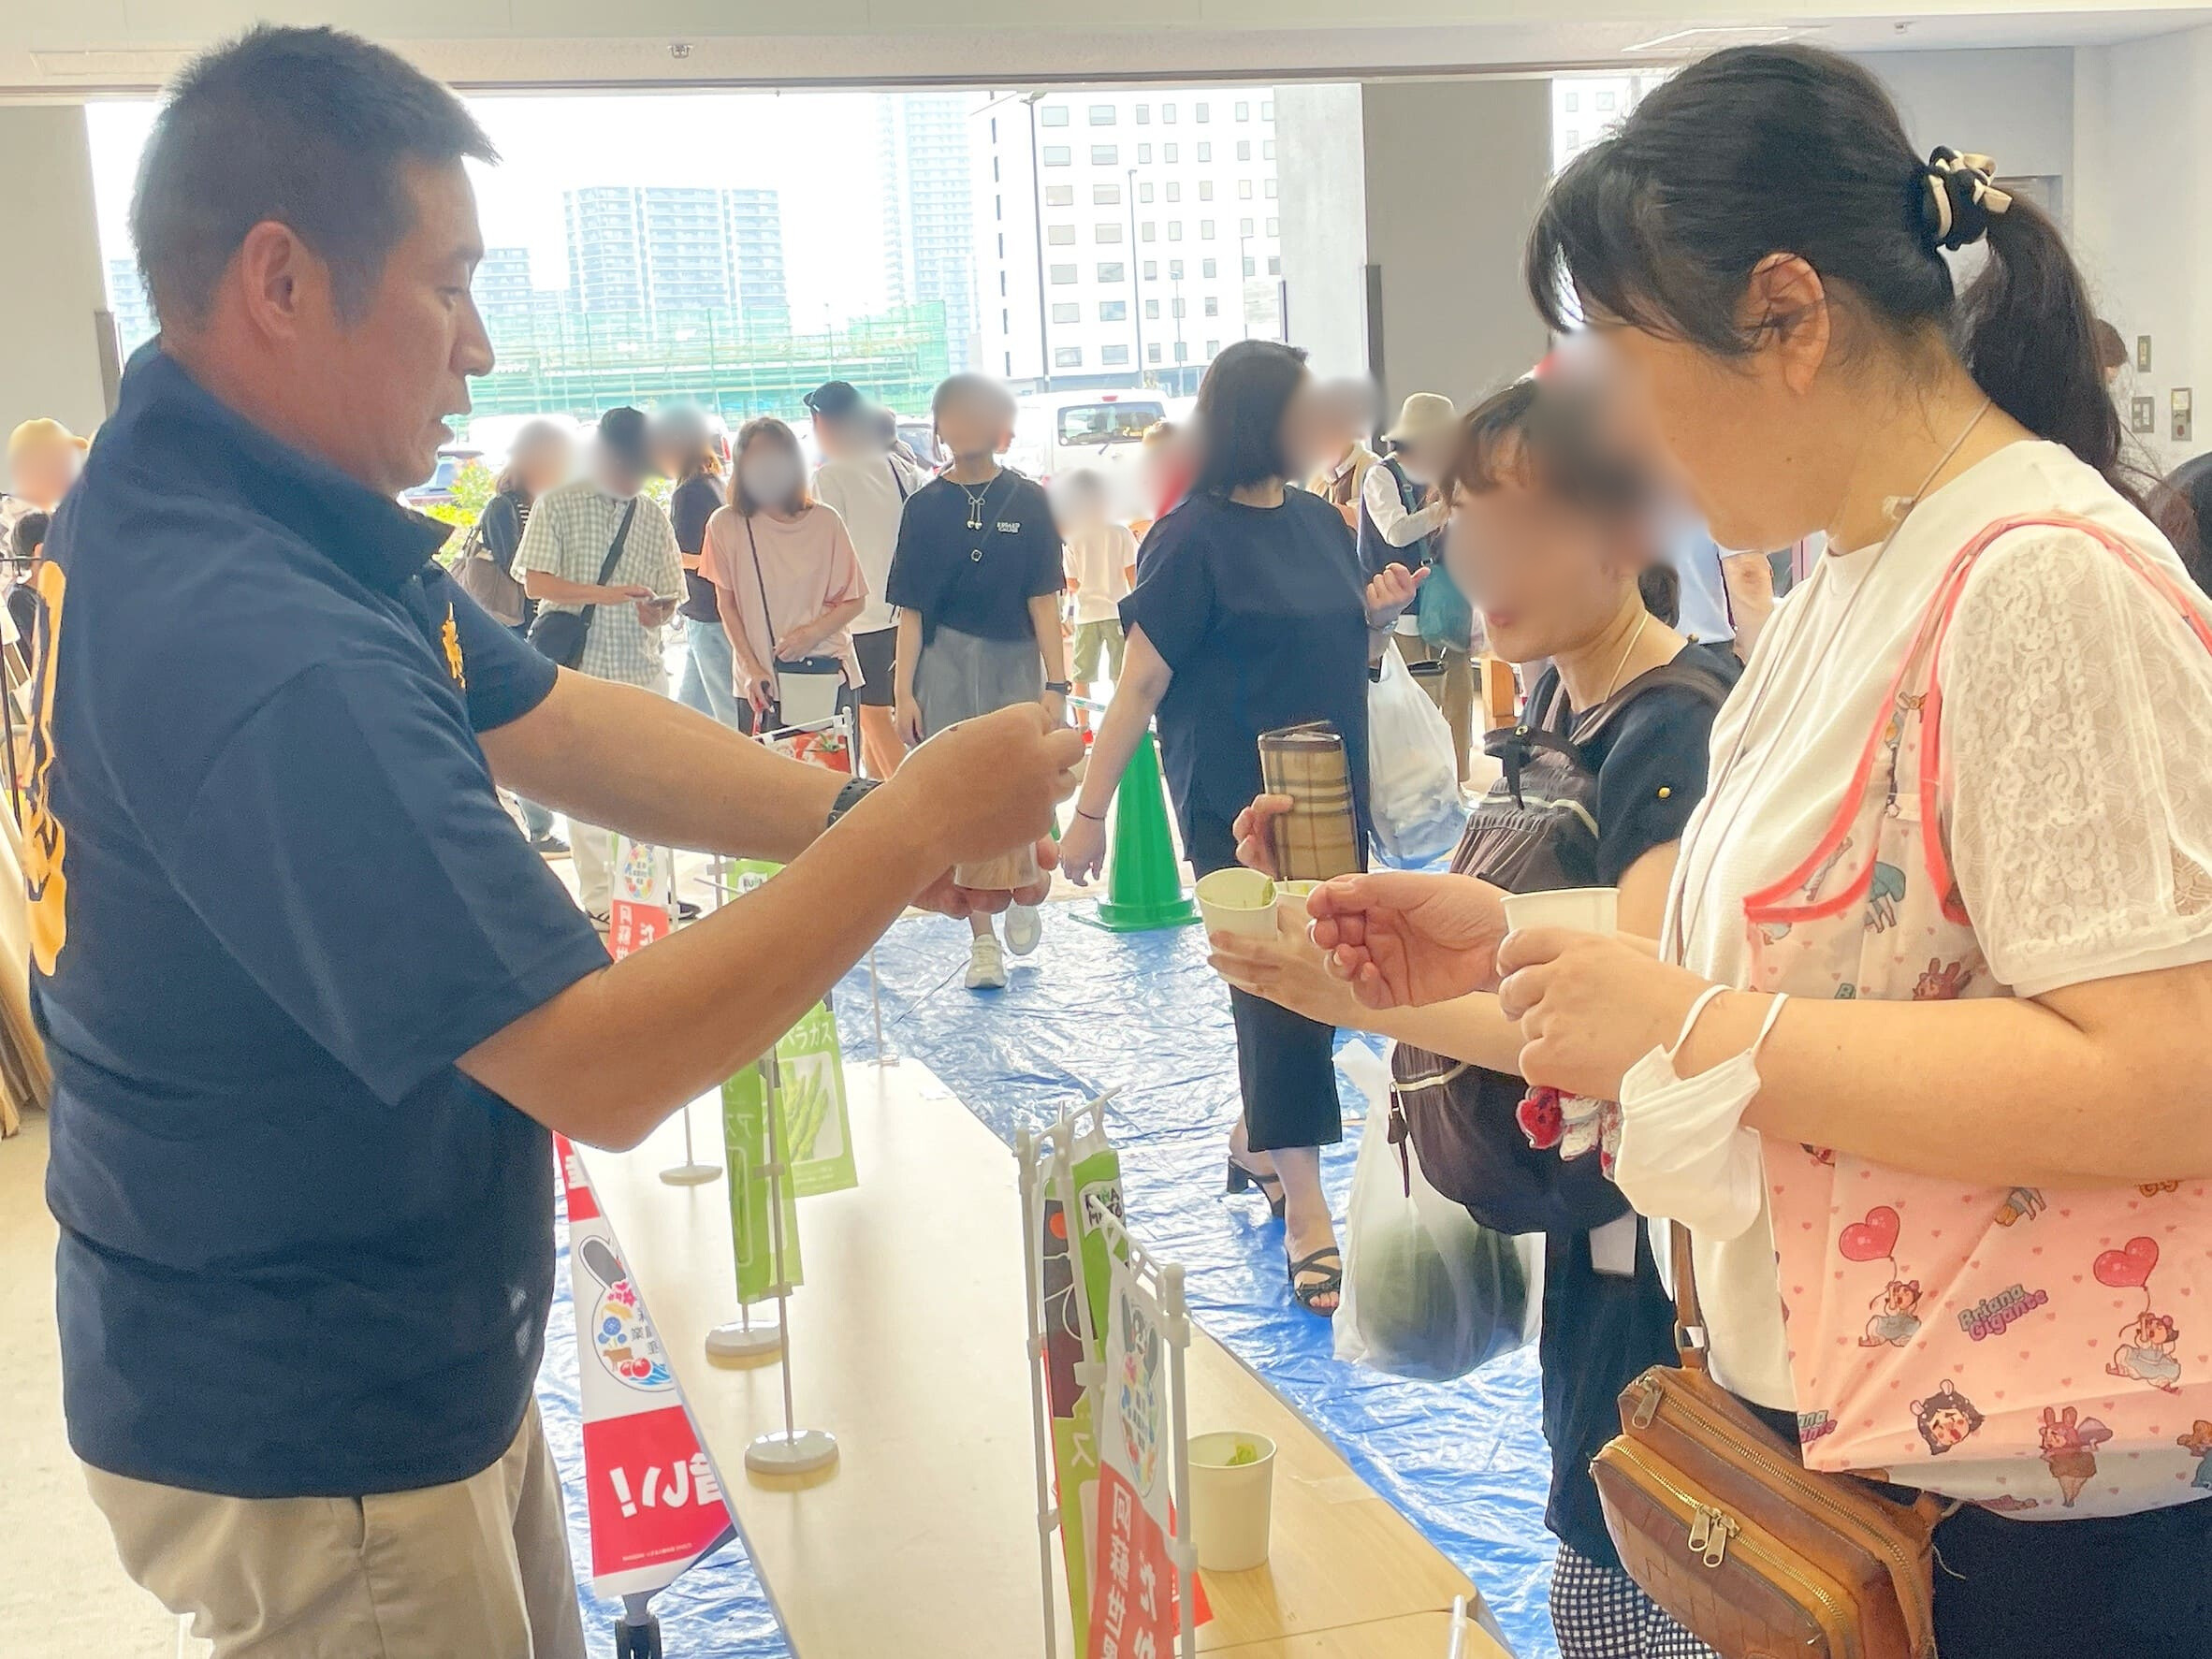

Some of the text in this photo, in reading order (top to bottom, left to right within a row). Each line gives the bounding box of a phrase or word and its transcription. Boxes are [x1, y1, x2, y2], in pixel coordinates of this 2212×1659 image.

[1957, 1284, 2023, 1332] Briana
[1969, 1289, 2048, 1341] Gigante
[1797, 1410, 1828, 1428] ana
